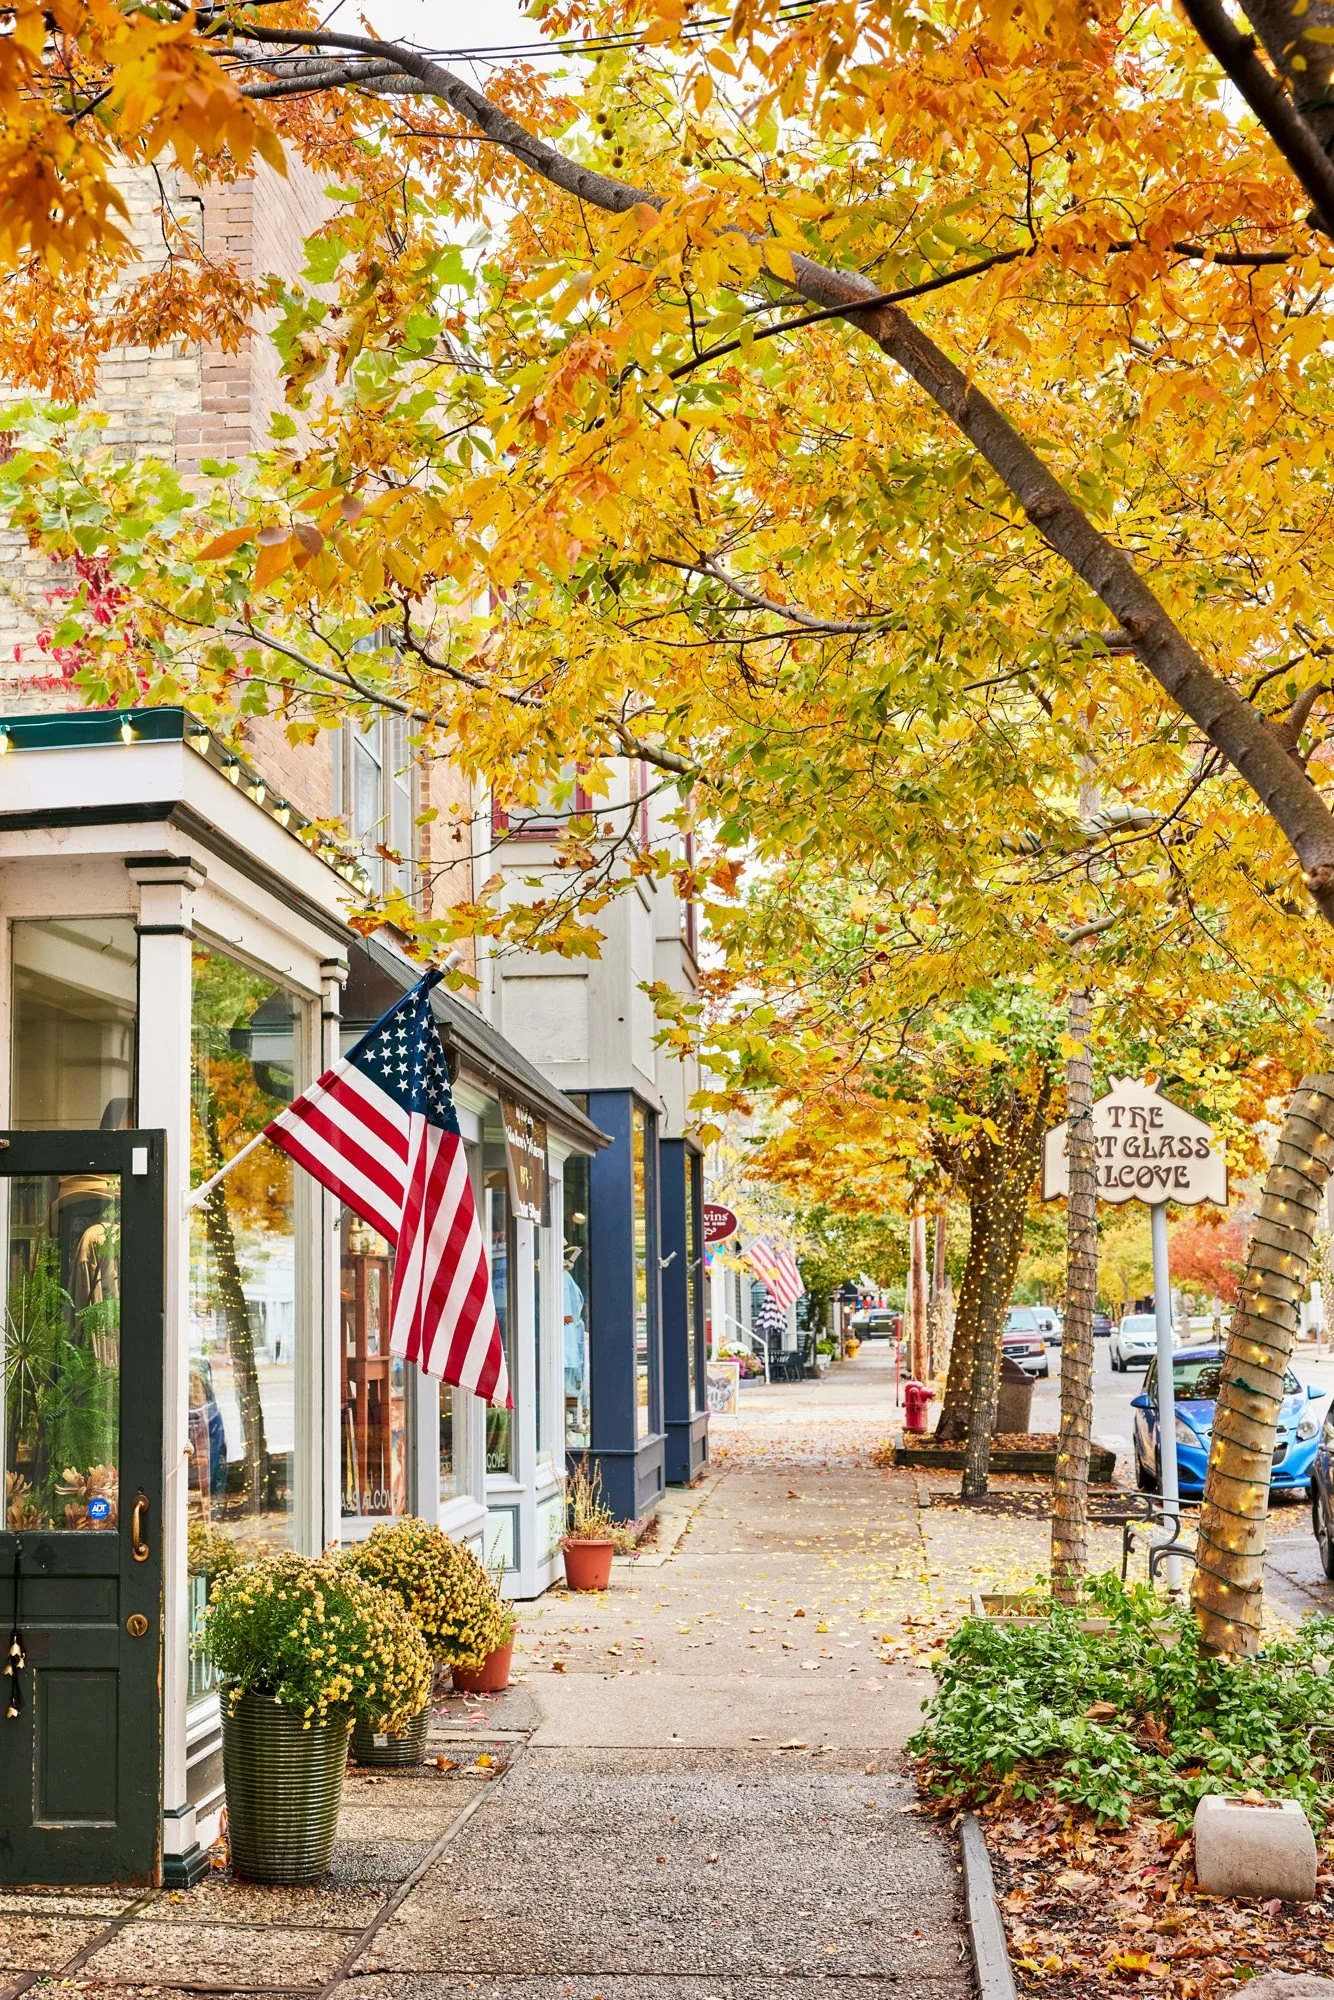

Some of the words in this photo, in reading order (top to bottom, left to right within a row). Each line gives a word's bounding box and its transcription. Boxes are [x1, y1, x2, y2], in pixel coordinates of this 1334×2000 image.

[1107, 1105, 1164, 1134] THE
[1123, 1135, 1210, 1158] GLASS
[92, 1504, 107, 1512] ADT
